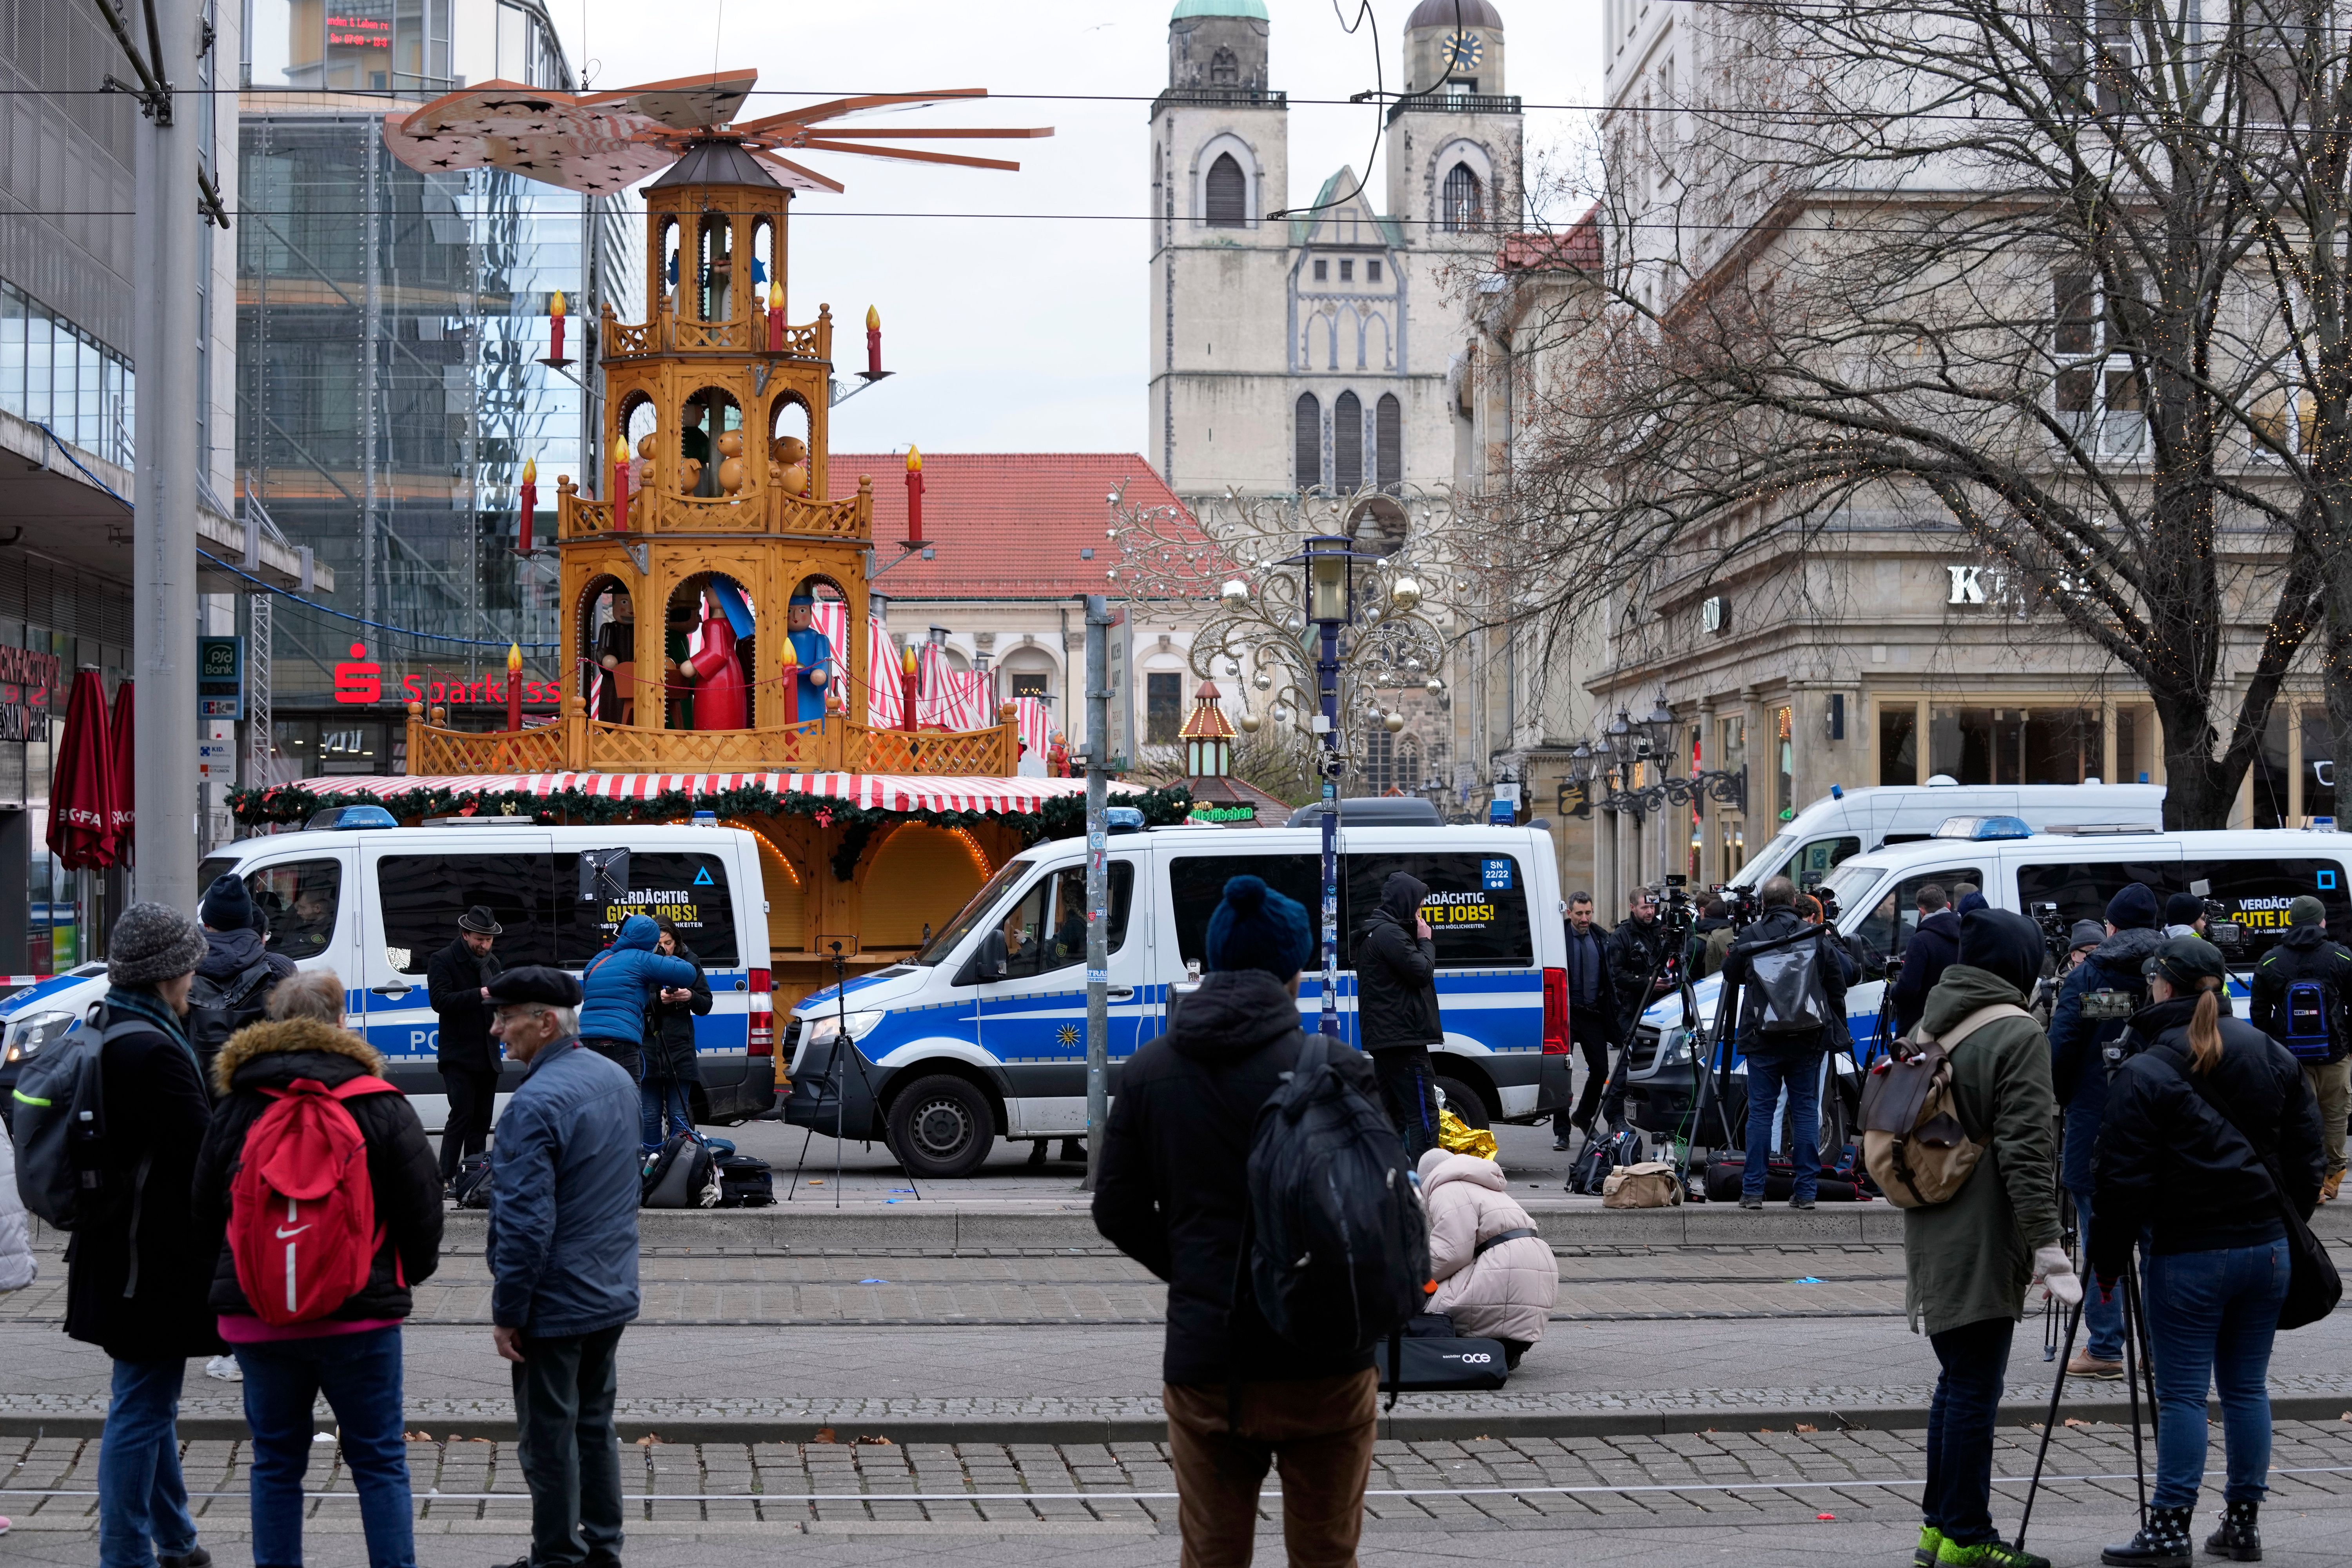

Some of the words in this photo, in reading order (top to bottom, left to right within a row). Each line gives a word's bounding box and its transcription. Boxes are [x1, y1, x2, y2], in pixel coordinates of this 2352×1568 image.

[357, 18, 377, 29] Leben
[205, 664, 233, 674] Bank
[403, 673, 561, 711] Sparkss
[2239, 896, 2296, 910] VERDÄCH
[1448, 904, 1494, 923] JOBS!
[1462, 1353, 1491, 1363] ace
